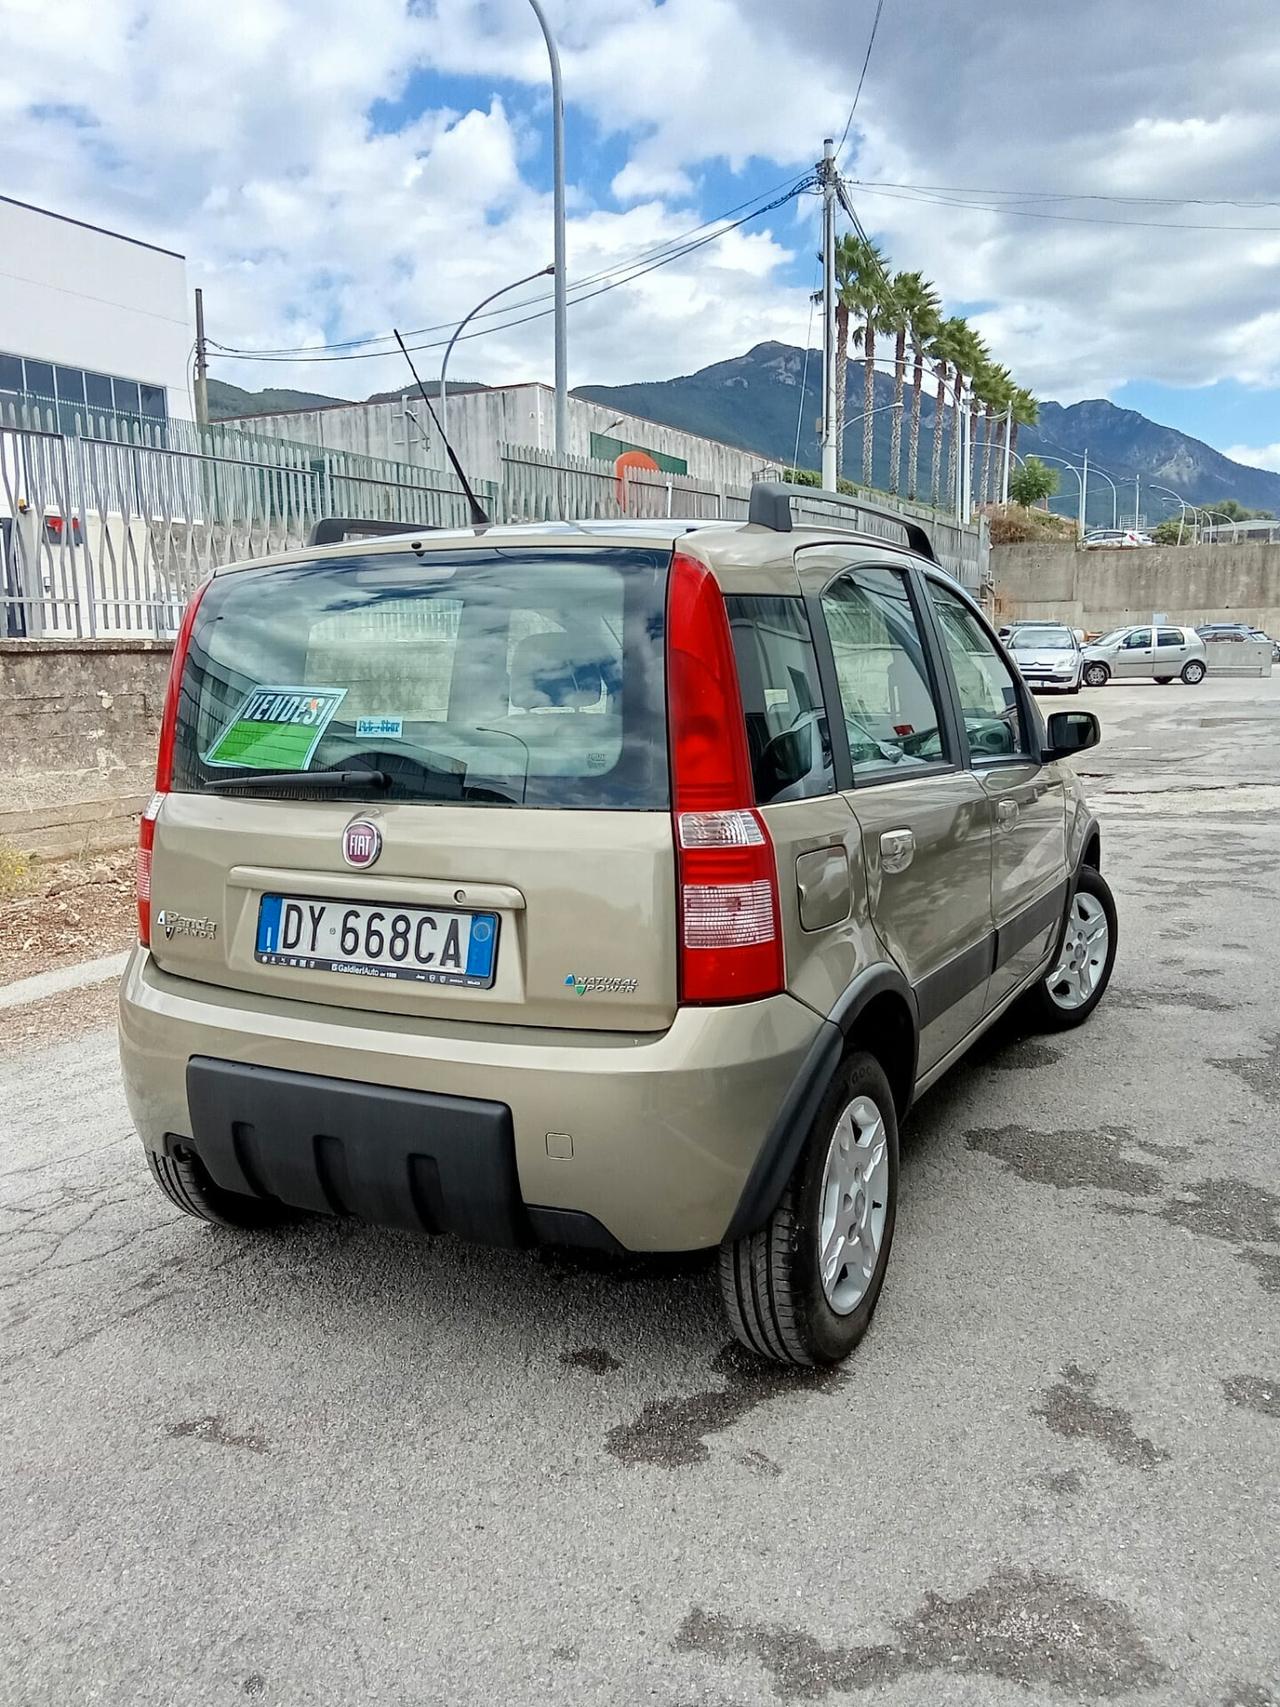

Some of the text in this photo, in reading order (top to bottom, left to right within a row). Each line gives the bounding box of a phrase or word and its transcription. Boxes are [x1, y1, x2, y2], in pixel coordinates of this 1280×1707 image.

[243, 693, 336, 726] VENDESI
[349, 835, 372, 856] FIAT
[165, 910, 217, 932] Panda
[282, 904, 327, 952] DY
[340, 909, 463, 968] 668CA
[576, 976, 639, 986] NATURAL
[585, 984, 636, 993] POWER
